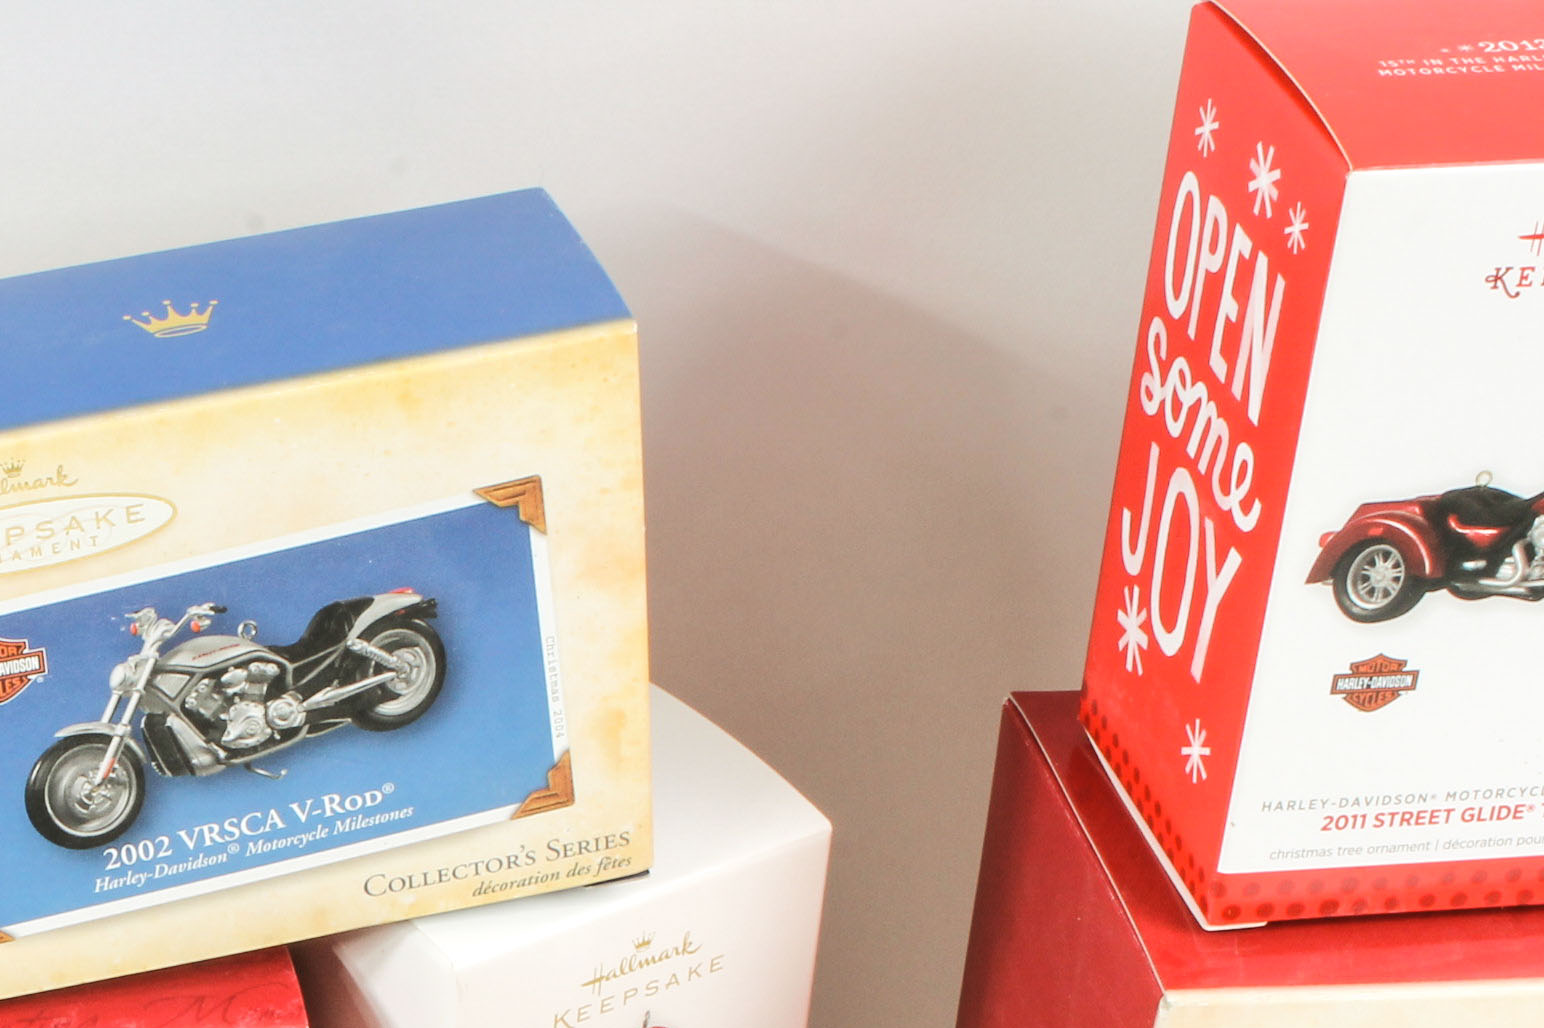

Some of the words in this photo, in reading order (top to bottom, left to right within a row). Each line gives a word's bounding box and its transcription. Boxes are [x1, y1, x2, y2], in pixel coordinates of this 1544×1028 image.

[1378, 64, 1506, 77] MOTORCYCLE
[1449, 56, 1487, 65] THE
[1165, 171, 1286, 426] OPEN
[1122, 441, 1243, 684] JOY
[104, 837, 173, 871] 2002
[177, 812, 287, 851] VRSCA
[246, 824, 329, 857] Motorcycle
[333, 806, 414, 835] Milestones
[1321, 814, 1366, 831] 2011
[1372, 808, 1455, 828] STREET
[1269, 847, 1332, 861] christmas
[1337, 844, 1363, 857] tree
[1367, 842, 1430, 855] ornament
[1442, 836, 1513, 851] décoration
[471, 871, 560, 897] décoration
[566, 862, 591, 879] des
[596, 855, 632, 877] fêtes
[581, 932, 702, 996] Hallmark
